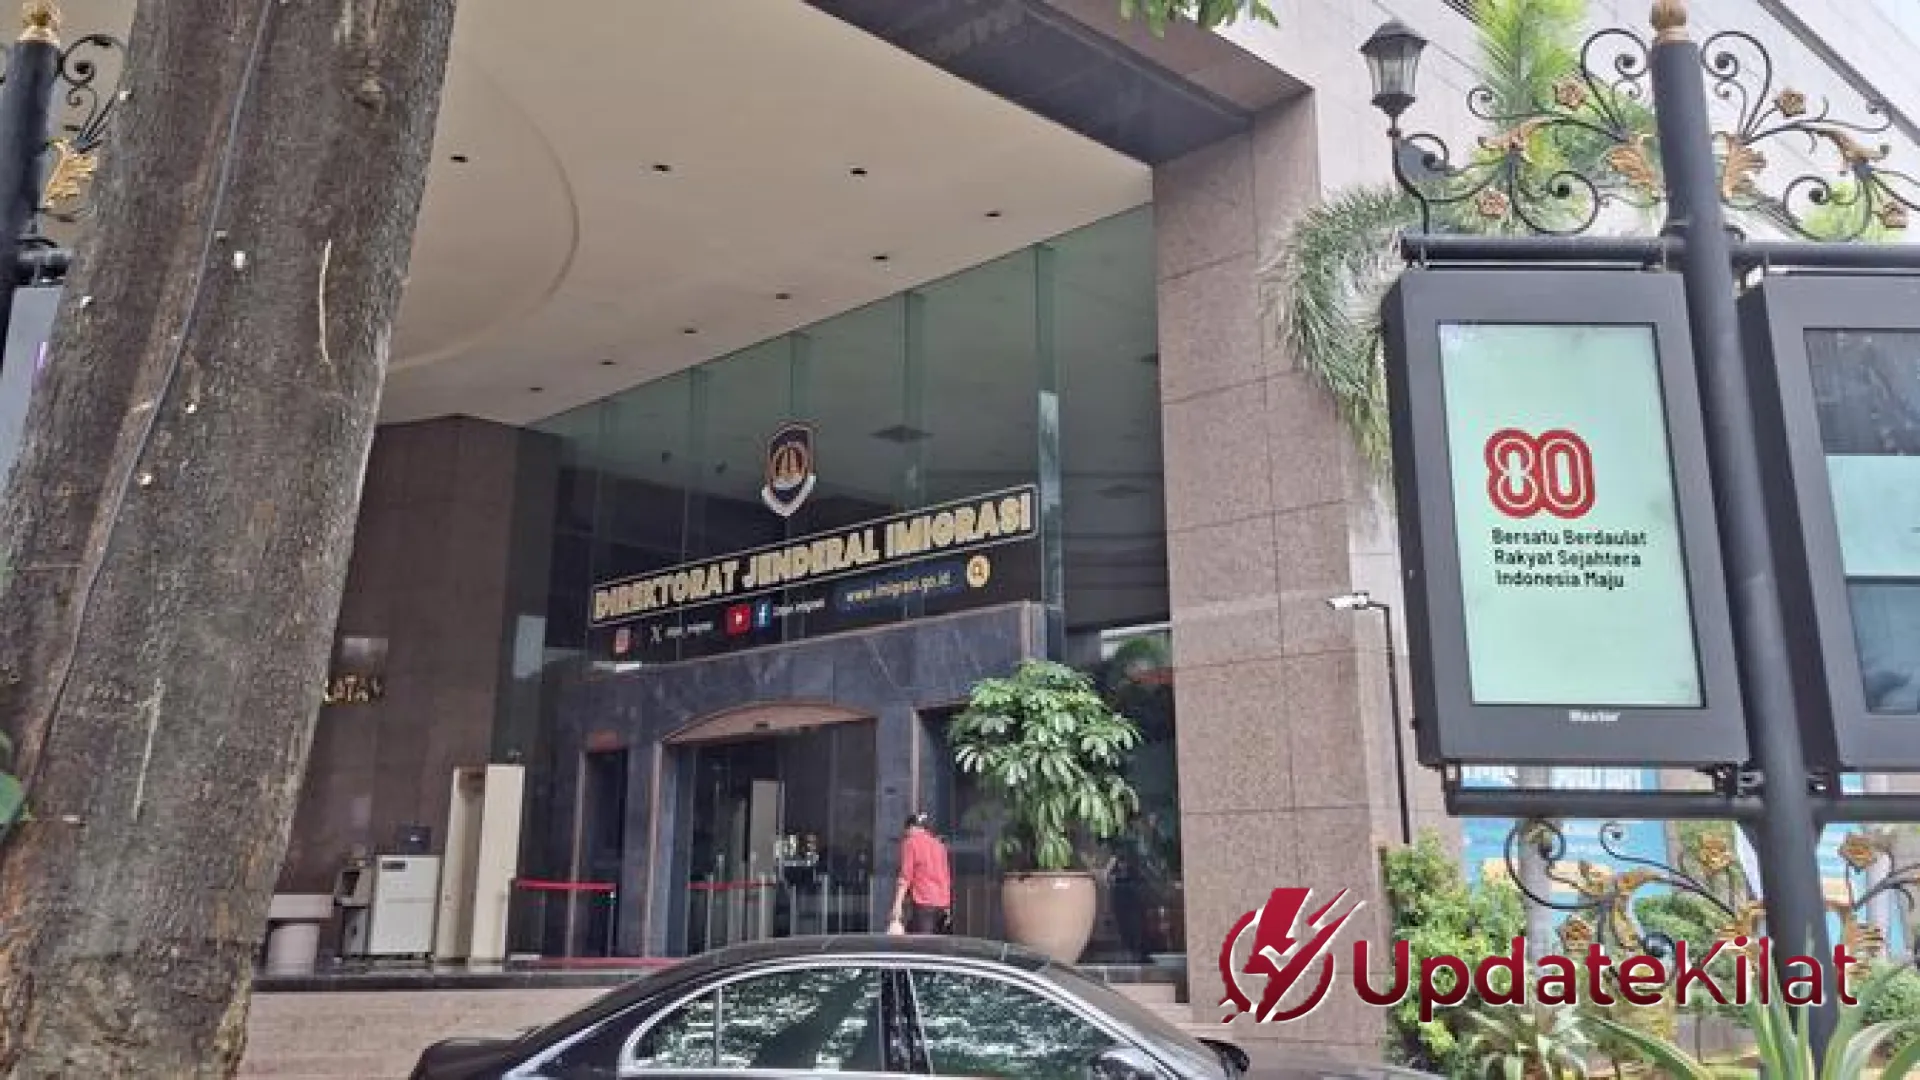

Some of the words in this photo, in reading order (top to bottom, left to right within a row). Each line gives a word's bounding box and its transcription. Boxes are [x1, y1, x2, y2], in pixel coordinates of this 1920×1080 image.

[1484, 428, 1595, 518] 80
[1491, 529, 1559, 545] Bersatu
[1563, 529, 1647, 545] Berdaulat
[595, 560, 739, 619] DIREKTORAT
[884, 493, 1031, 558] IMIGRASI
[1494, 550, 1553, 568] Rakyat
[1557, 551, 1641, 569] Sejahtera
[1496, 571, 1580, 585] Indonesia
[1585, 572, 1624, 590] Maju
